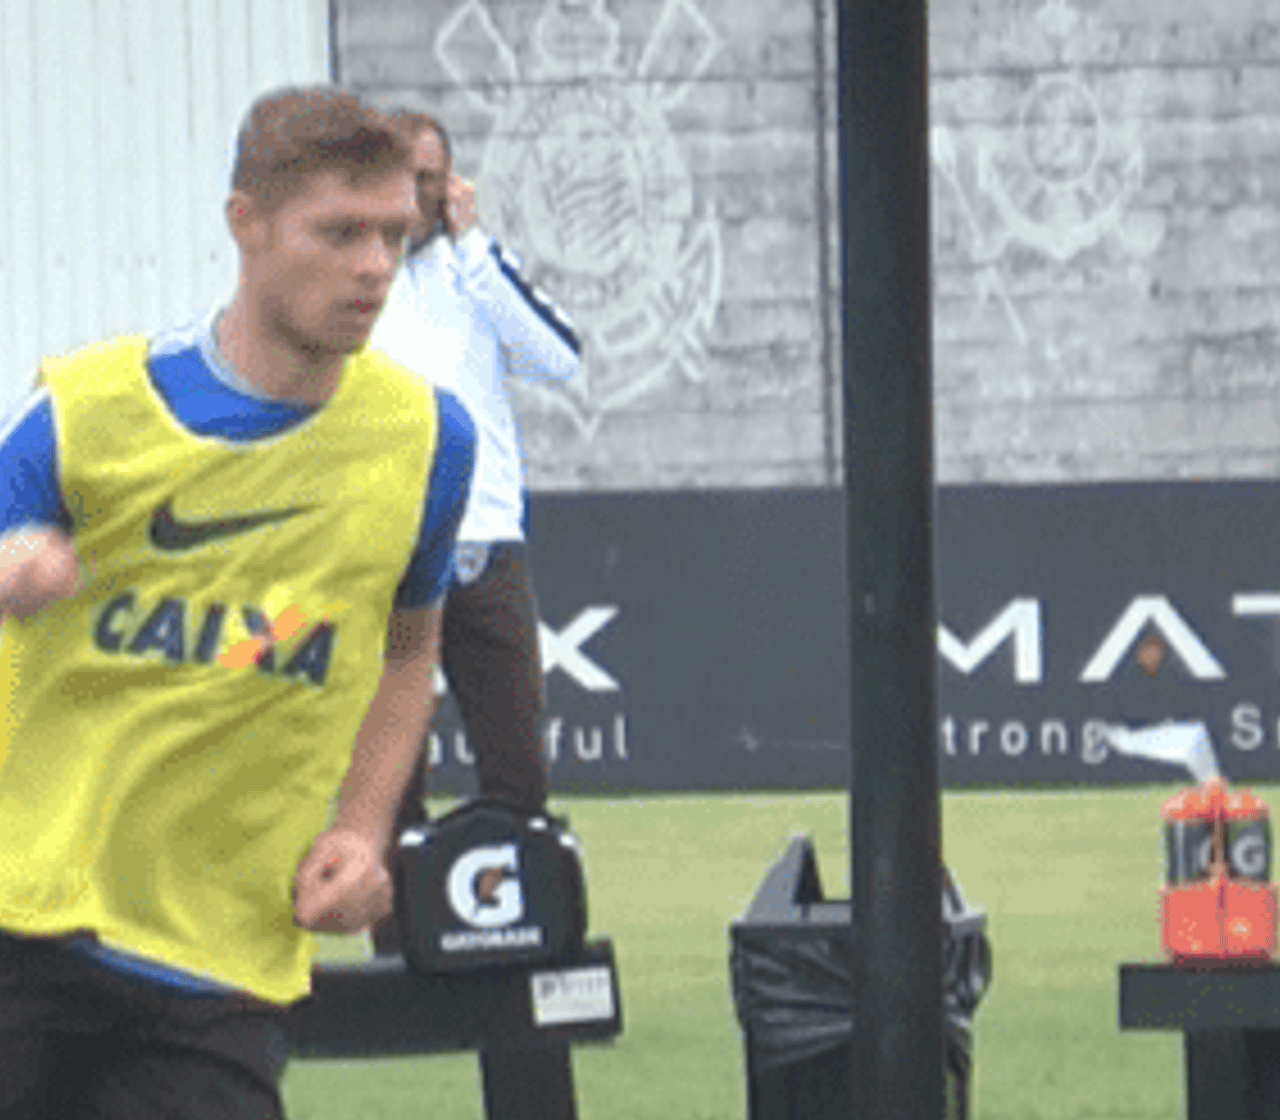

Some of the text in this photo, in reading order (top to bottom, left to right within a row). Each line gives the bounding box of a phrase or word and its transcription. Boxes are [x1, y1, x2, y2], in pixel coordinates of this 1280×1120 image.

[92, 591, 340, 687] CAIXA
[940, 715, 1109, 765] trong
[447, 844, 524, 928] G
